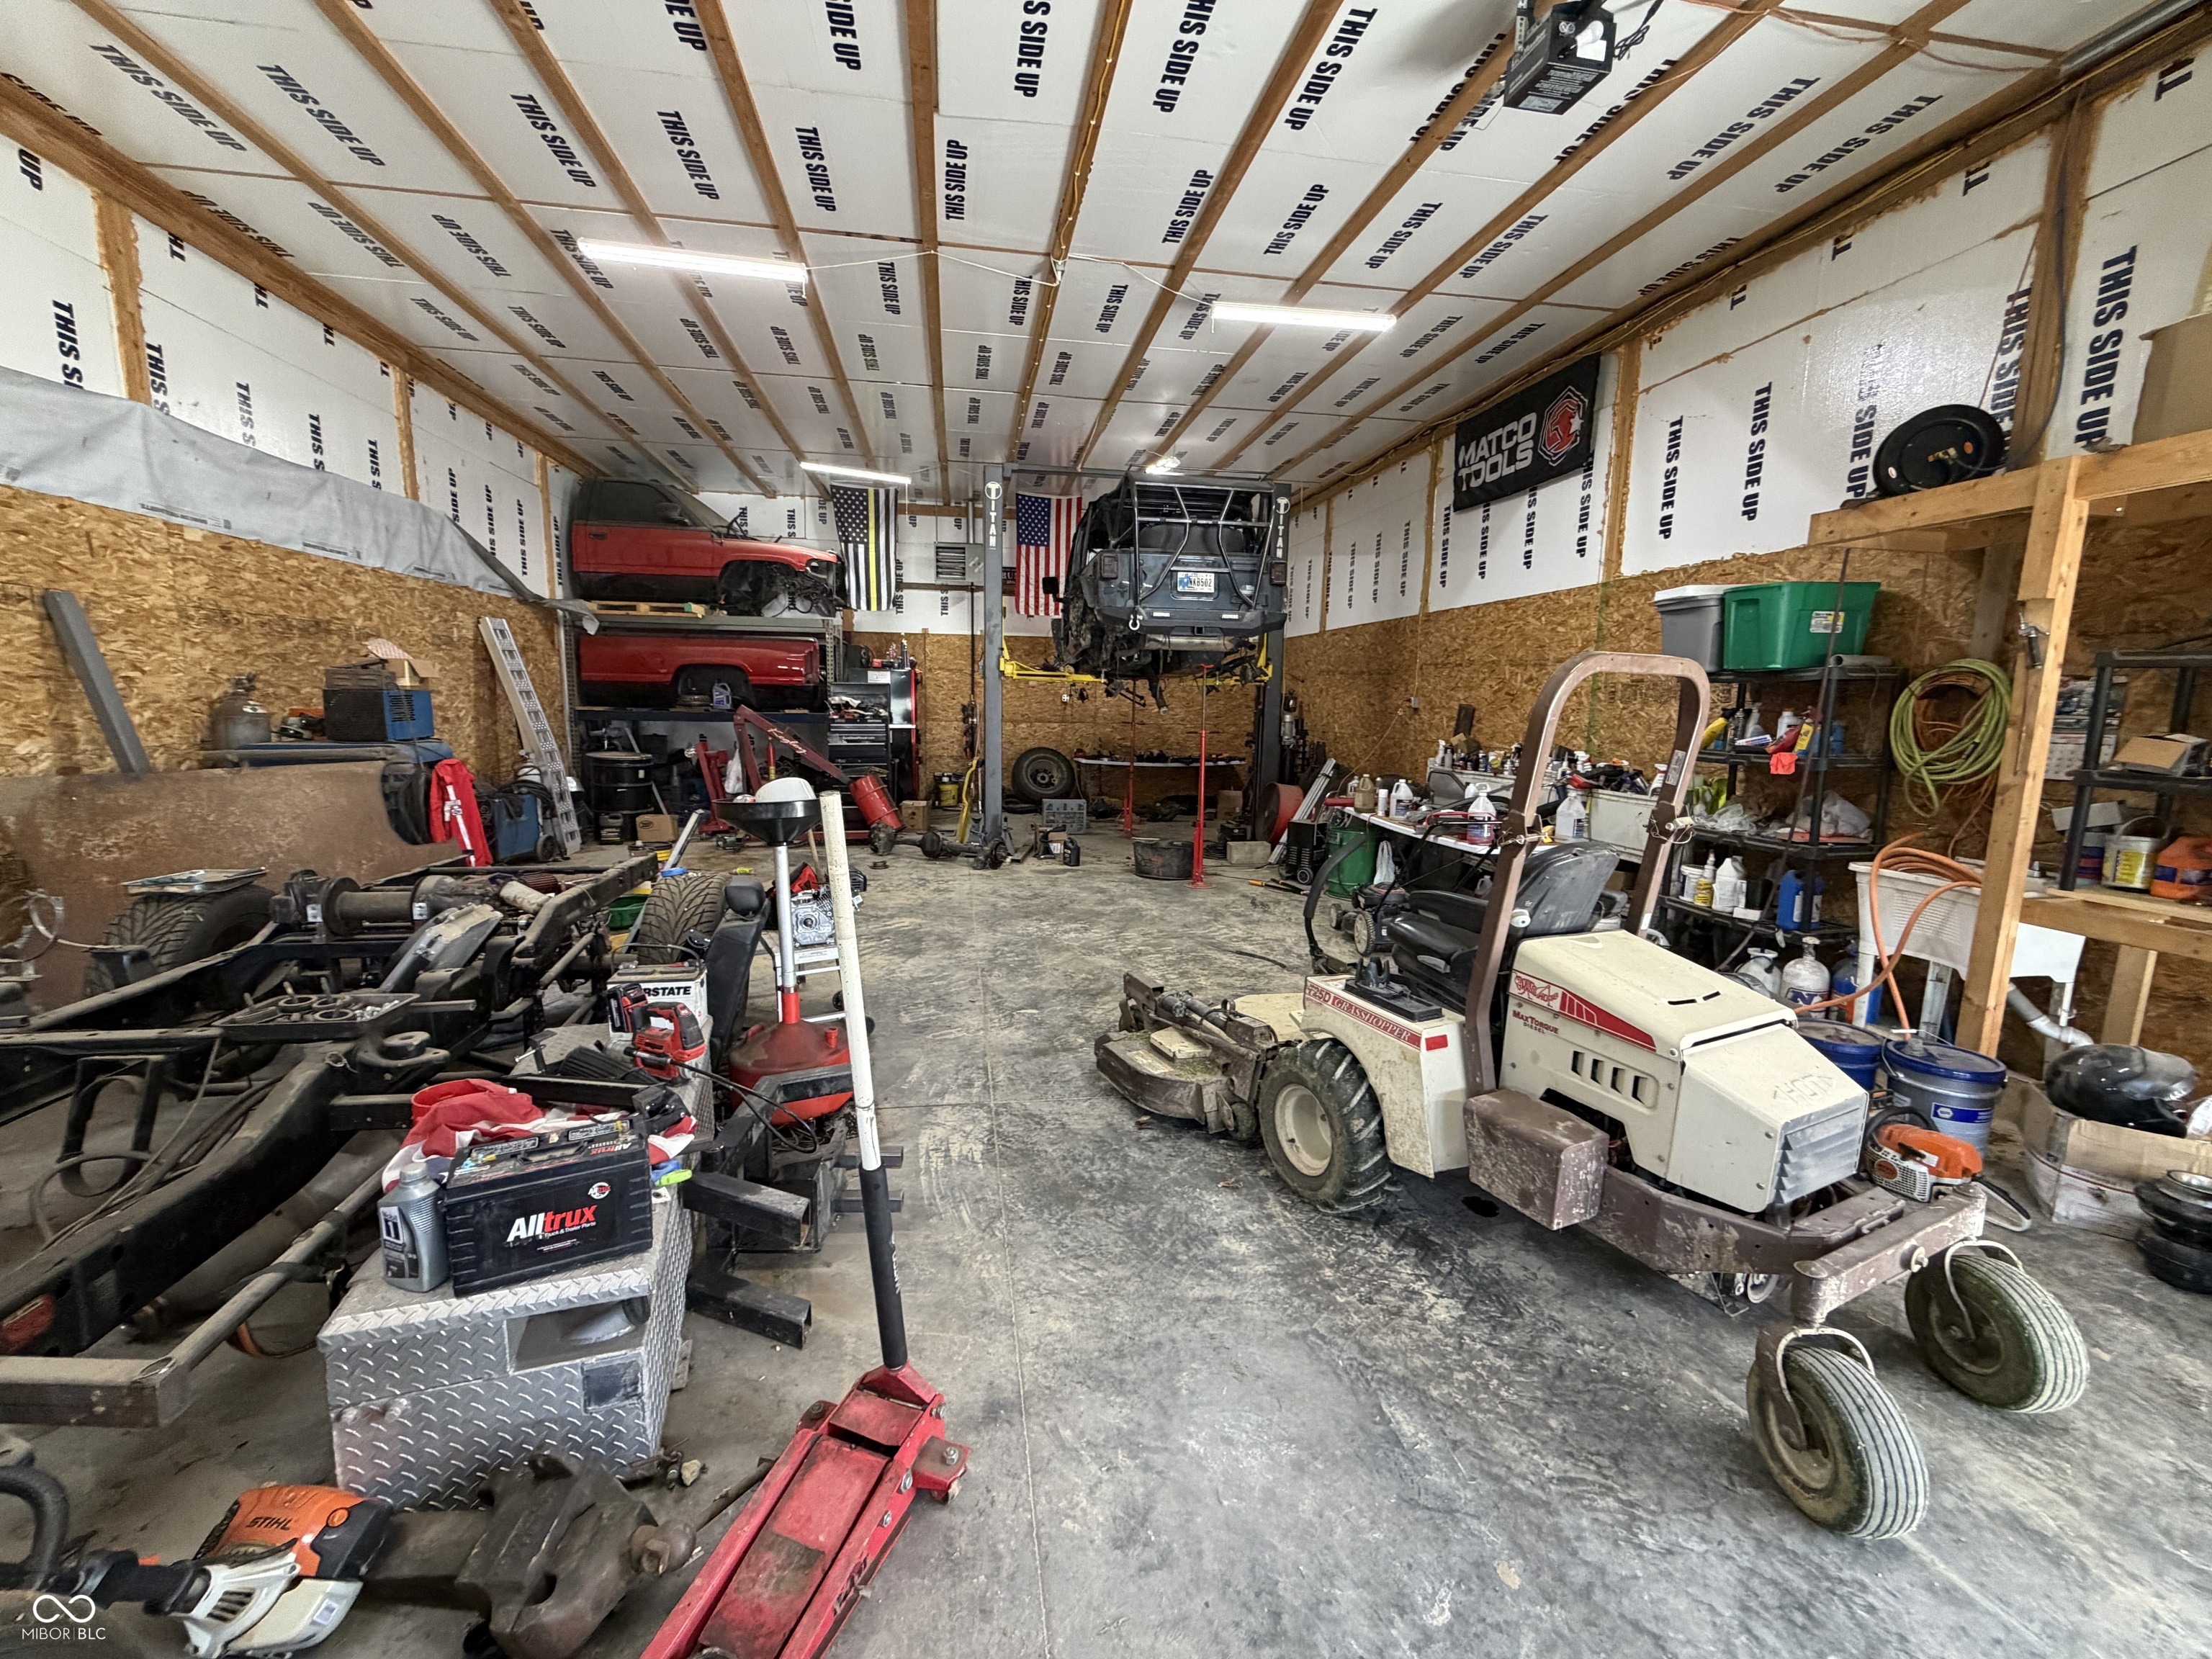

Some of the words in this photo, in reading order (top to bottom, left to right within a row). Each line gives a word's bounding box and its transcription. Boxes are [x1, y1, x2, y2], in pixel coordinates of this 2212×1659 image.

[824, 0, 858, 40] IDE
[1178, 0, 1218, 36] HIS
[673, 21, 708, 51] UP
[1016, 20, 1048, 70] SIDE
[1326, 8, 1377, 58] THIS
[832, 42, 862, 71] UP
[1160, 39, 1200, 86] SIDE
[1013, 72, 1040, 98] UP
[1296, 61, 1343, 105] SIDE
[89, 44, 164, 87] THIS
[151, 90, 218, 128] SIDE
[204, 130, 247, 151] UP
[1152, 88, 1181, 113] UP
[1746, 77, 1820, 119] THIS
[256, 64, 320, 105] THIS
[305, 107, 363, 145] SIDE
[348, 145, 385, 166] UP
[1284, 107, 1315, 131] UP
[1864, 95, 1941, 134] THIS
[510, 94, 557, 132] THIS
[540, 133, 583, 168] SIDE
[566, 168, 597, 188] UP
[657, 110, 695, 147] THIS
[1691, 122, 1755, 158] SIDE
[795, 127, 825, 161] THIS
[946, 139, 968, 160] UP
[1802, 137, 1869, 172] SIDE
[18, 148, 43, 191] UP
[676, 148, 711, 181] SIDE
[944, 161, 967, 192] SIDE
[1667, 160, 1702, 180] UP
[693, 182, 720, 200] UP
[805, 163, 833, 194] SIDE
[1189, 169, 1214, 189] UP
[1774, 174, 1812, 193] UP
[307, 202, 343, 219] UP
[814, 194, 837, 212] UP
[944, 193, 966, 220] THIS
[1175, 189, 1205, 220] SIDE
[1401, 202, 1443, 229] THIS
[330, 220, 376, 245] SIDE
[431, 214, 462, 230] UP
[1161, 219, 1190, 244] THIS
[1263, 231, 1296, 256] THIS
[1282, 203, 1318, 230] SIDE
[1302, 184, 1329, 202] UP
[1503, 214, 1549, 240] THIS
[448, 230, 488, 255] SIDE
[1376, 230, 1413, 255] SIDE
[1473, 241, 1514, 265] SIDE
[364, 246, 405, 269] THIS
[475, 256, 511, 277] THIS
[1364, 255, 1388, 269] UP
[571, 253, 603, 276] SIDE
[590, 276, 614, 289] UP
[876, 261, 897, 283] THIS
[1459, 265, 1484, 279] UP
[881, 283, 900, 304] SIDE
[1013, 275, 1034, 296] THIS
[1106, 284, 1129, 305] THIS
[2092, 244, 2137, 328] THIS
[884, 303, 902, 315] UP
[1010, 296, 1029, 315] SIDE
[1098, 305, 1120, 323] SIDE
[52, 299, 81, 361] THIS
[410, 297, 444, 315] THIS
[434, 315, 467, 332] SIDE
[456, 331, 480, 341] UP
[507, 306, 539, 323] THIS
[527, 323, 557, 339] SIDE
[545, 338, 567, 349] UP
[680, 318, 699, 328] UP
[770, 326, 788, 336] UP
[1008, 315, 1025, 326] UP
[1094, 323, 1112, 333] UP
[1184, 312, 1211, 331] SIDE
[1430, 315, 1465, 333] THIS
[1509, 323, 1546, 340] THIS
[686, 328, 710, 344] SIDE
[774, 336, 795, 351] SIDE
[858, 333, 874, 343] UP
[1178, 328, 1196, 340] UP
[1408, 333, 1439, 349] SIDE
[698, 343, 719, 359] THIS
[781, 351, 801, 365] THIS
[860, 343, 877, 358] SIDE
[1399, 349, 1419, 358] UP
[1475, 355, 1495, 364] UP
[1485, 339, 1519, 356] SIDE
[61, 363, 85, 390] SI
[145, 341, 168, 397] THIS
[863, 358, 880, 372] THIS
[2080, 328, 2123, 405] SIDE
[235, 381, 255, 430] THIS
[1750, 381, 1773, 436] THIS
[308, 413, 324, 456] THIS
[1458, 412, 1537, 468] MATCO
[1665, 415, 1683, 464] THIS
[1850, 404, 1877, 463] SIDE
[367, 438, 381, 478] THIS
[1457, 439, 1534, 492] TOOLS
[1744, 439, 1766, 490] SIDE
[1660, 465, 1678, 511] SIDE
[1845, 464, 1869, 498] UP
[516, 498, 524, 516] UP
[786, 508, 796, 530] THIS
[986, 482, 1001, 547] TITAN
[1577, 493, 1592, 534] SIDE
[1740, 492, 1760, 521] UP
[518, 518, 526, 547] SIDE
[953, 518, 963, 531] UP
[1276, 498, 1290, 559] TITAN
[1442, 504, 1452, 536] THIS
[1524, 511, 1537, 547] SIDE
[1658, 513, 1673, 540] UP
[1440, 537, 1449, 569] SIDE
[1479, 525, 1490, 559] SIDE
[1575, 535, 1588, 558] UP
[1478, 560, 1487, 580] UP
[1522, 549, 1534, 570] UP
[1399, 580, 1406, 597] UP
[1439, 570, 1447, 588] UP
[643, 986, 692, 997] RSTATE
[1334, 999, 1412, 1041] GRASSHOPPER
[505, 1204, 598, 1243] Alltrux
[245, 1516, 293, 1532] STIHL
